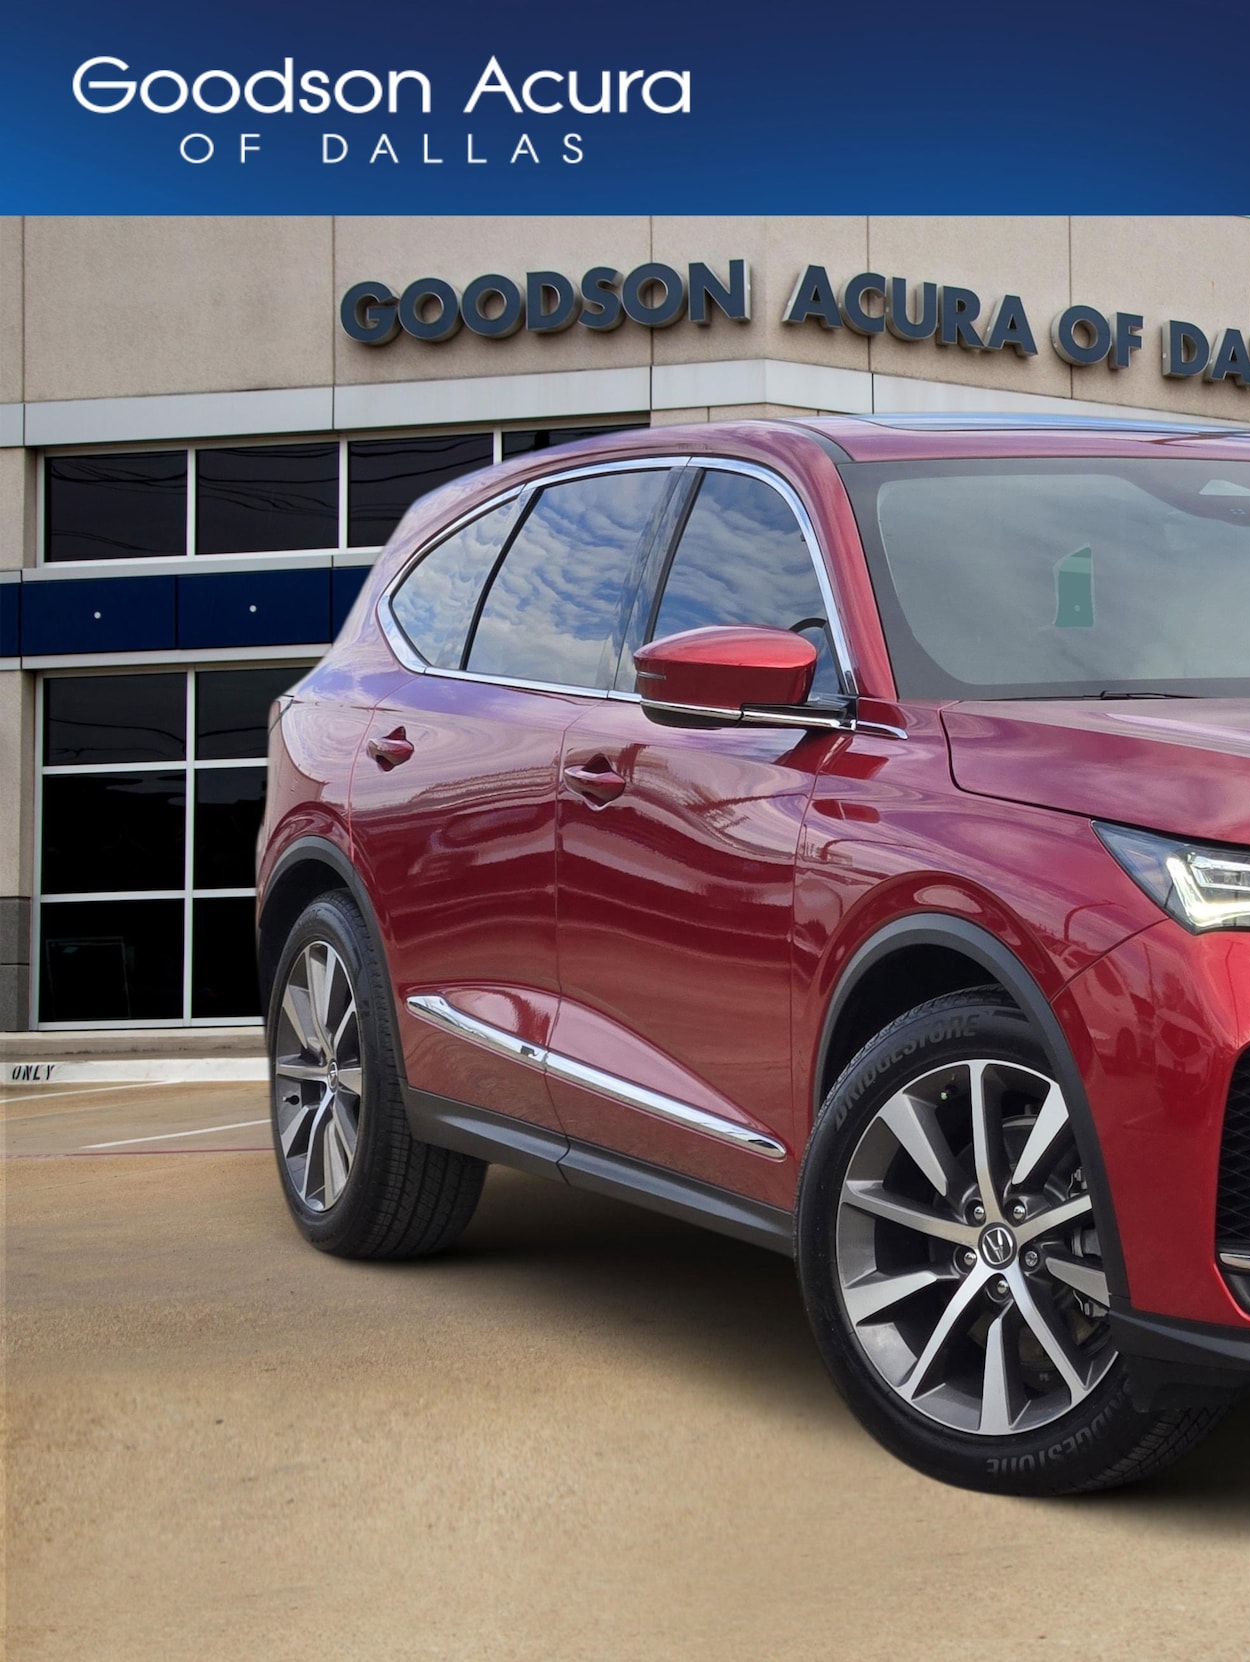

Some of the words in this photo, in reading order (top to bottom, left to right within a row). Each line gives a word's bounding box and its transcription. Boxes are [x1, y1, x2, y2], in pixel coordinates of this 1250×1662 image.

[340, 259, 752, 346] GOODSON
[783, 264, 1038, 357] ACURA
[1051, 304, 1144, 369] OF
[12, 1064, 55, 1081] ONLY
